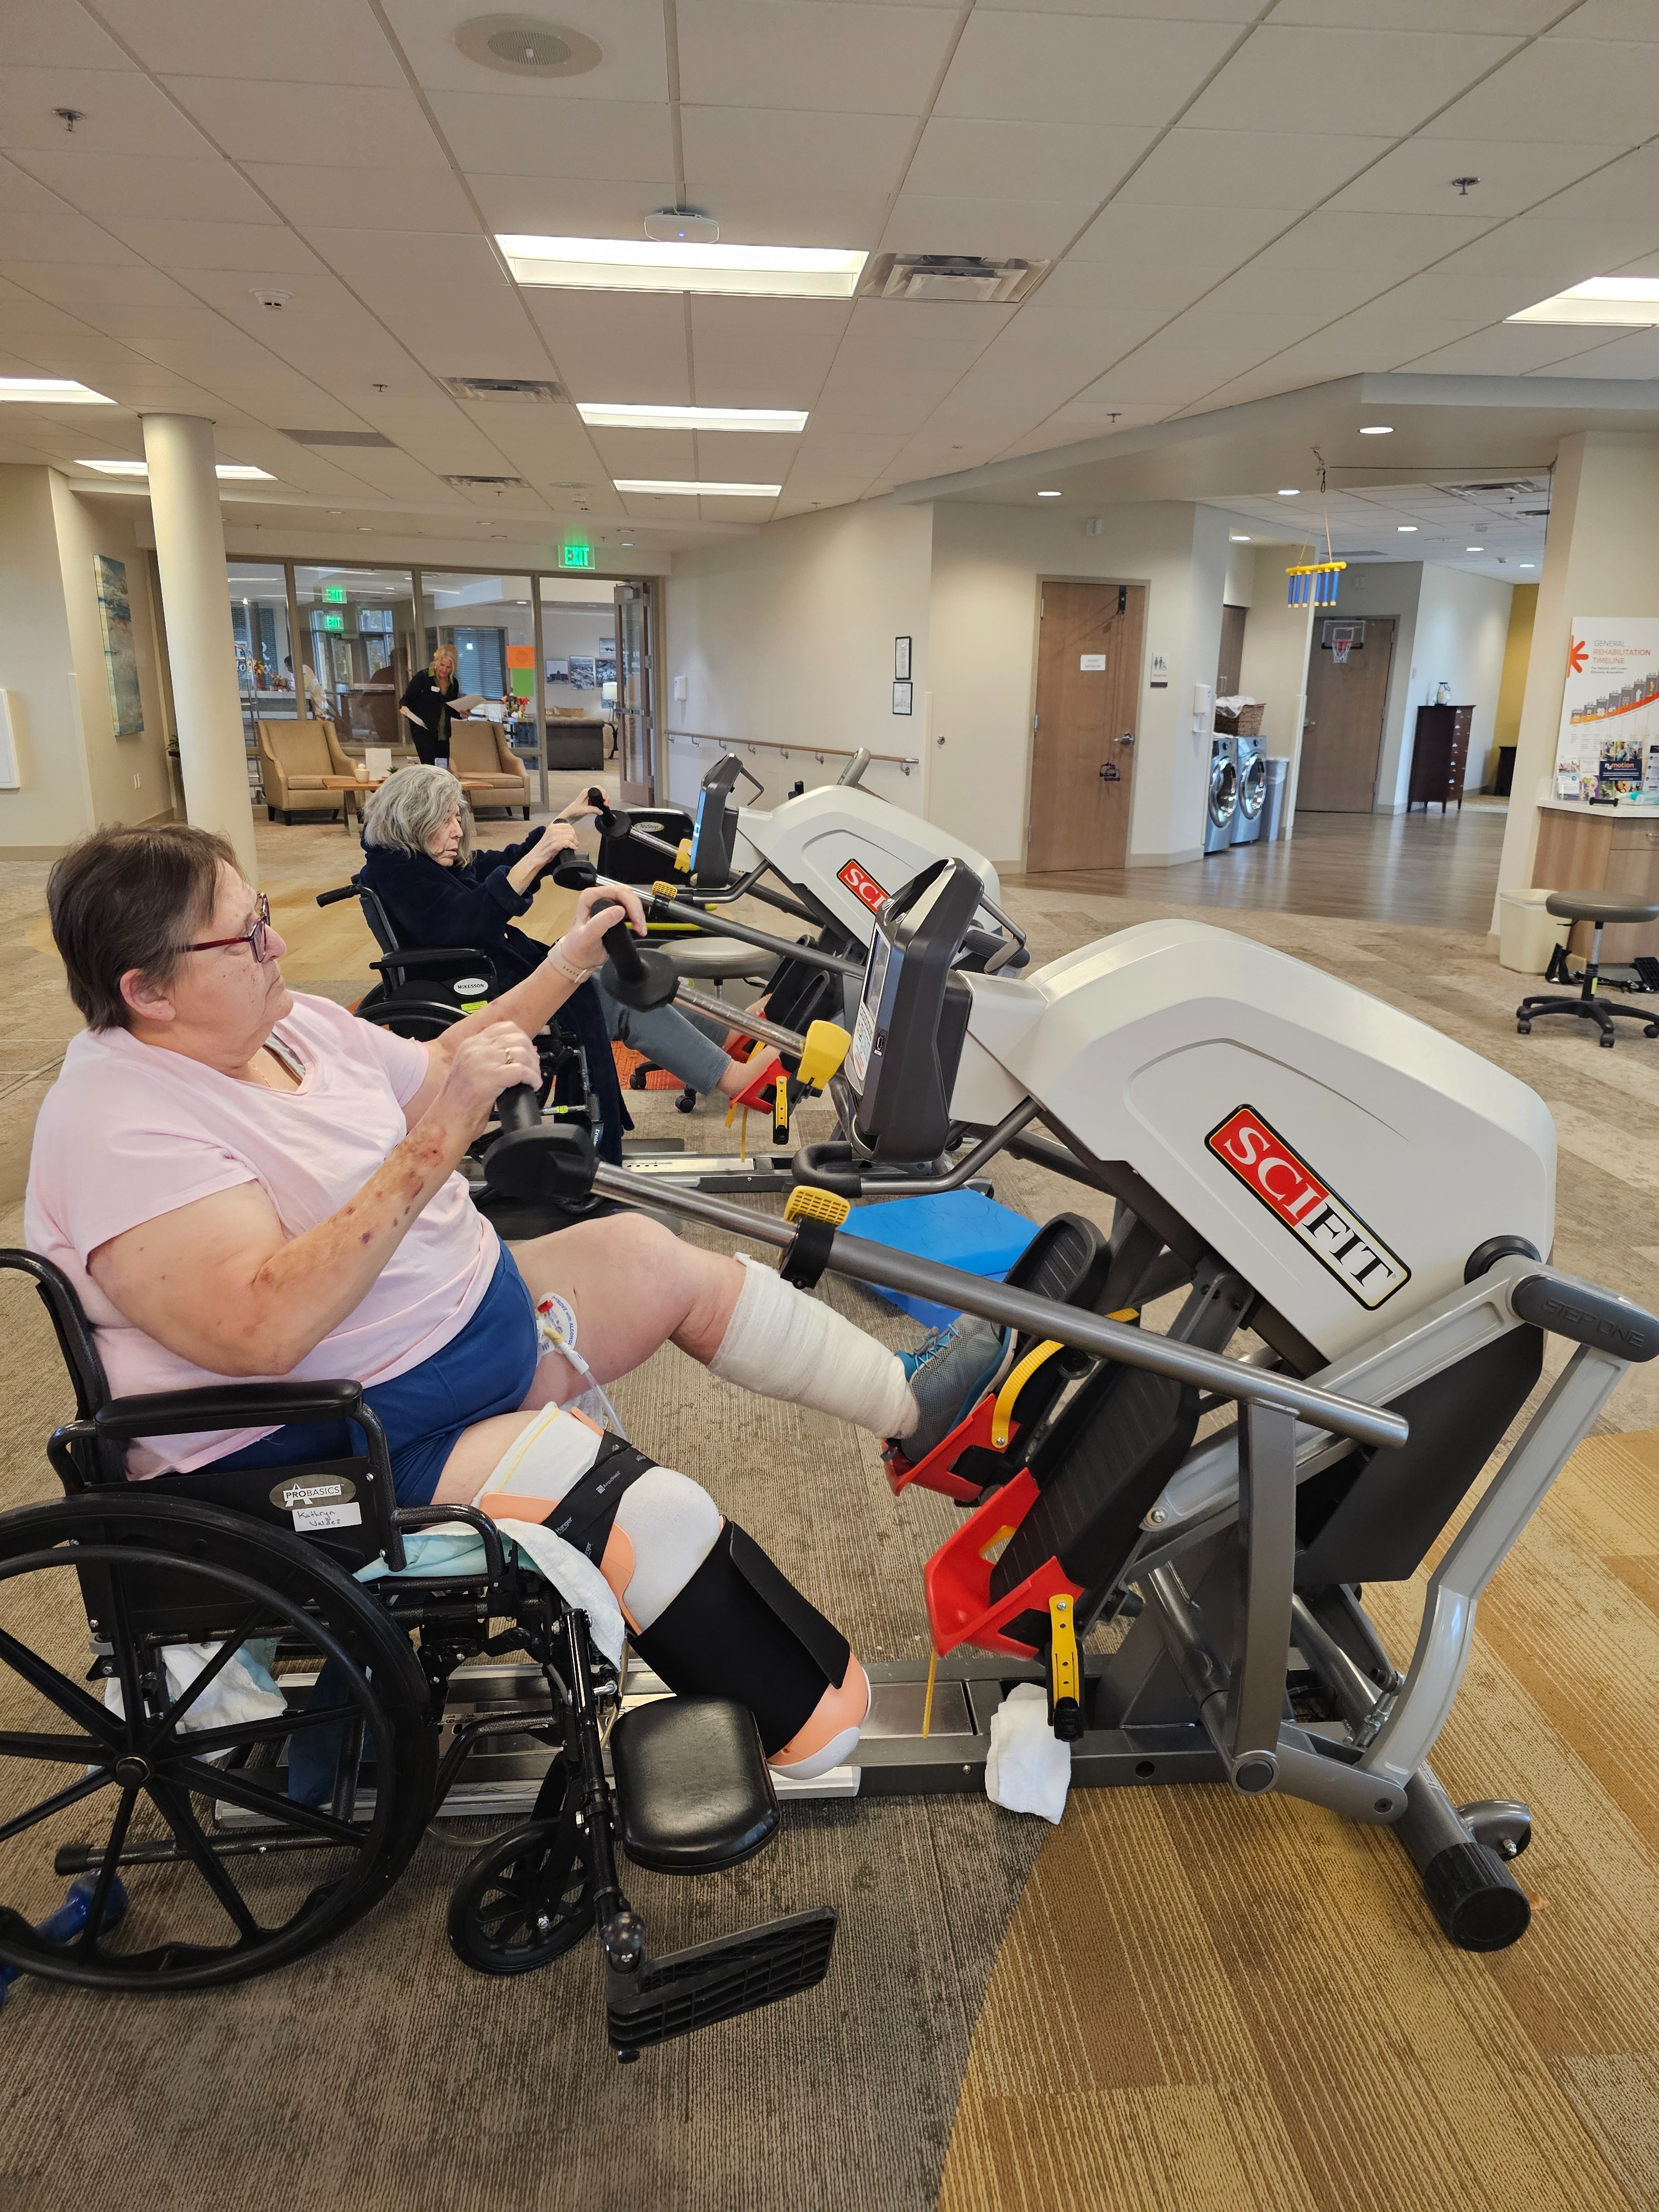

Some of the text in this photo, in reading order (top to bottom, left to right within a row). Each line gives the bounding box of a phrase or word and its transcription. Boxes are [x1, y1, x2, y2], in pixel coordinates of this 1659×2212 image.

[564, 546, 589, 566] EXIT
[326, 589, 343, 602] EXIT
[326, 615, 341, 628] EXIT
[844, 868, 886, 910] SCI
[1223, 1126, 1394, 1287] SCIFIT
[1597, 1318, 1645, 1348] ONE
[286, 1486, 340, 1499] PROBASICS
[446, 1714, 456, 1724] 19
